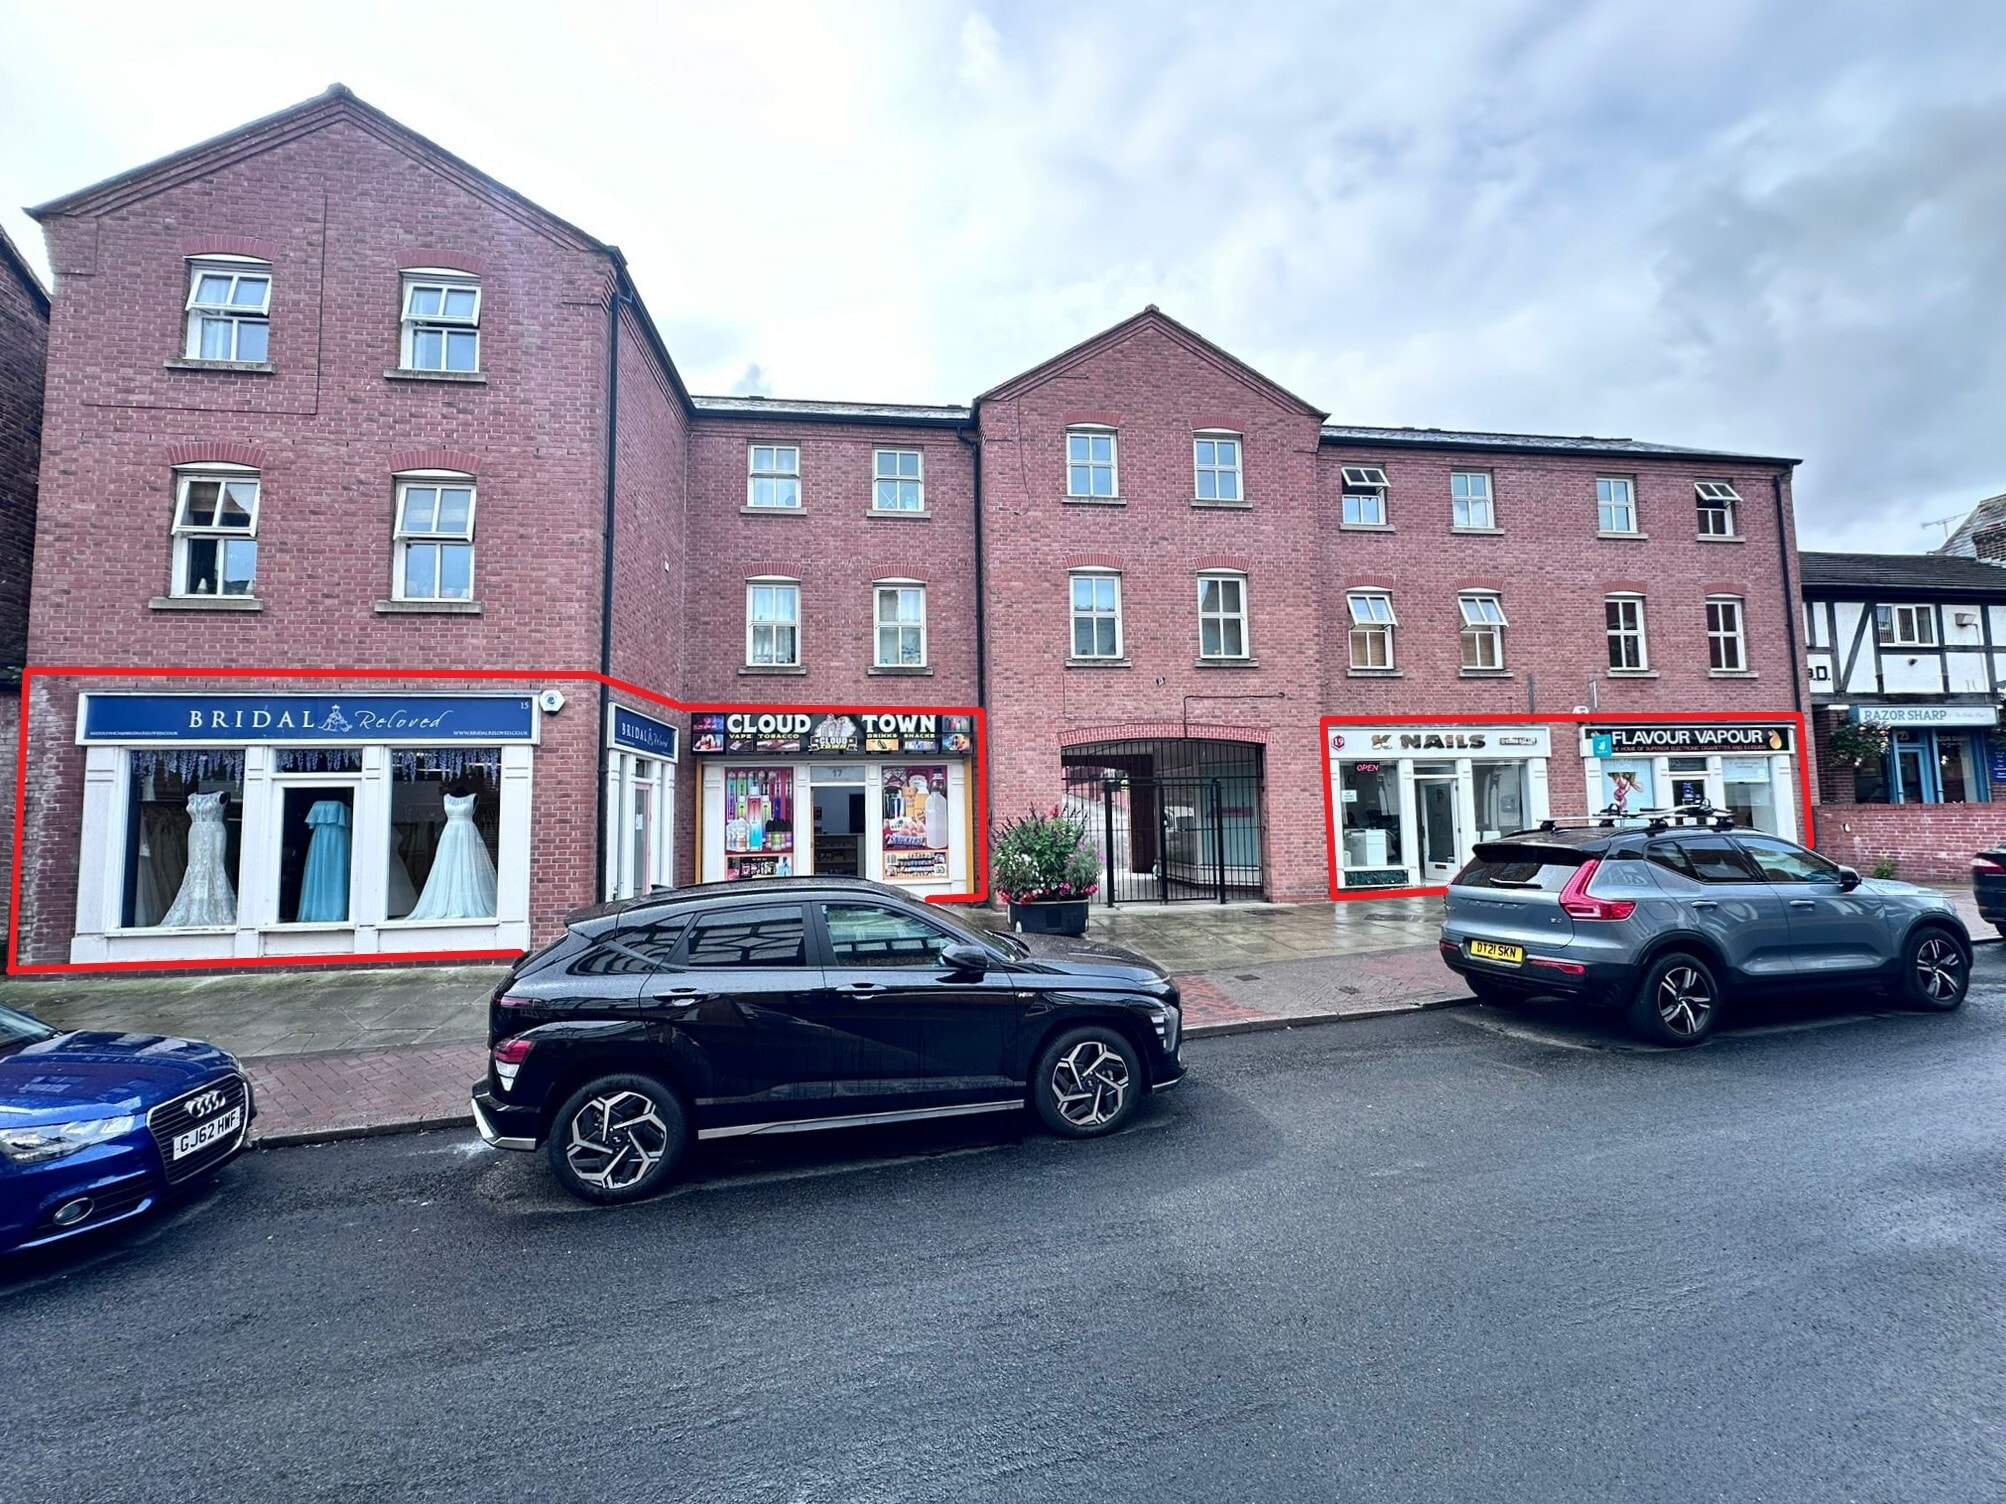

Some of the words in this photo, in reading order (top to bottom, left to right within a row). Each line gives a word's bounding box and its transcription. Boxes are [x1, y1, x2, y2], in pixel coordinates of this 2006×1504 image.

[188, 710, 315, 728] BRIDAL
[354, 709, 453, 729] Reloved
[1864, 710, 1905, 720] RAZOR
[1907, 710, 1947, 720] SHARP
[727, 713, 811, 733] CLOUD
[861, 714, 936, 733] TOWN
[621, 722, 647, 742] BRIDAL
[1612, 731, 1690, 745] FLAVOUR
[1695, 730, 1763, 744] VAPOUR
[819, 736, 848, 745] CLOUD
[1333, 738, 1344, 747] 19
[1371, 735, 1392, 750] K
[1399, 734, 1486, 749] NAILS
[832, 769, 843, 778] 17
[1356, 763, 1380, 772] OPEN
[1477, 942, 1496, 955] DT21
[1498, 946, 1516, 958] SKN
[180, 1123, 214, 1152] GJ62
[217, 1111, 236, 1134] HWF
